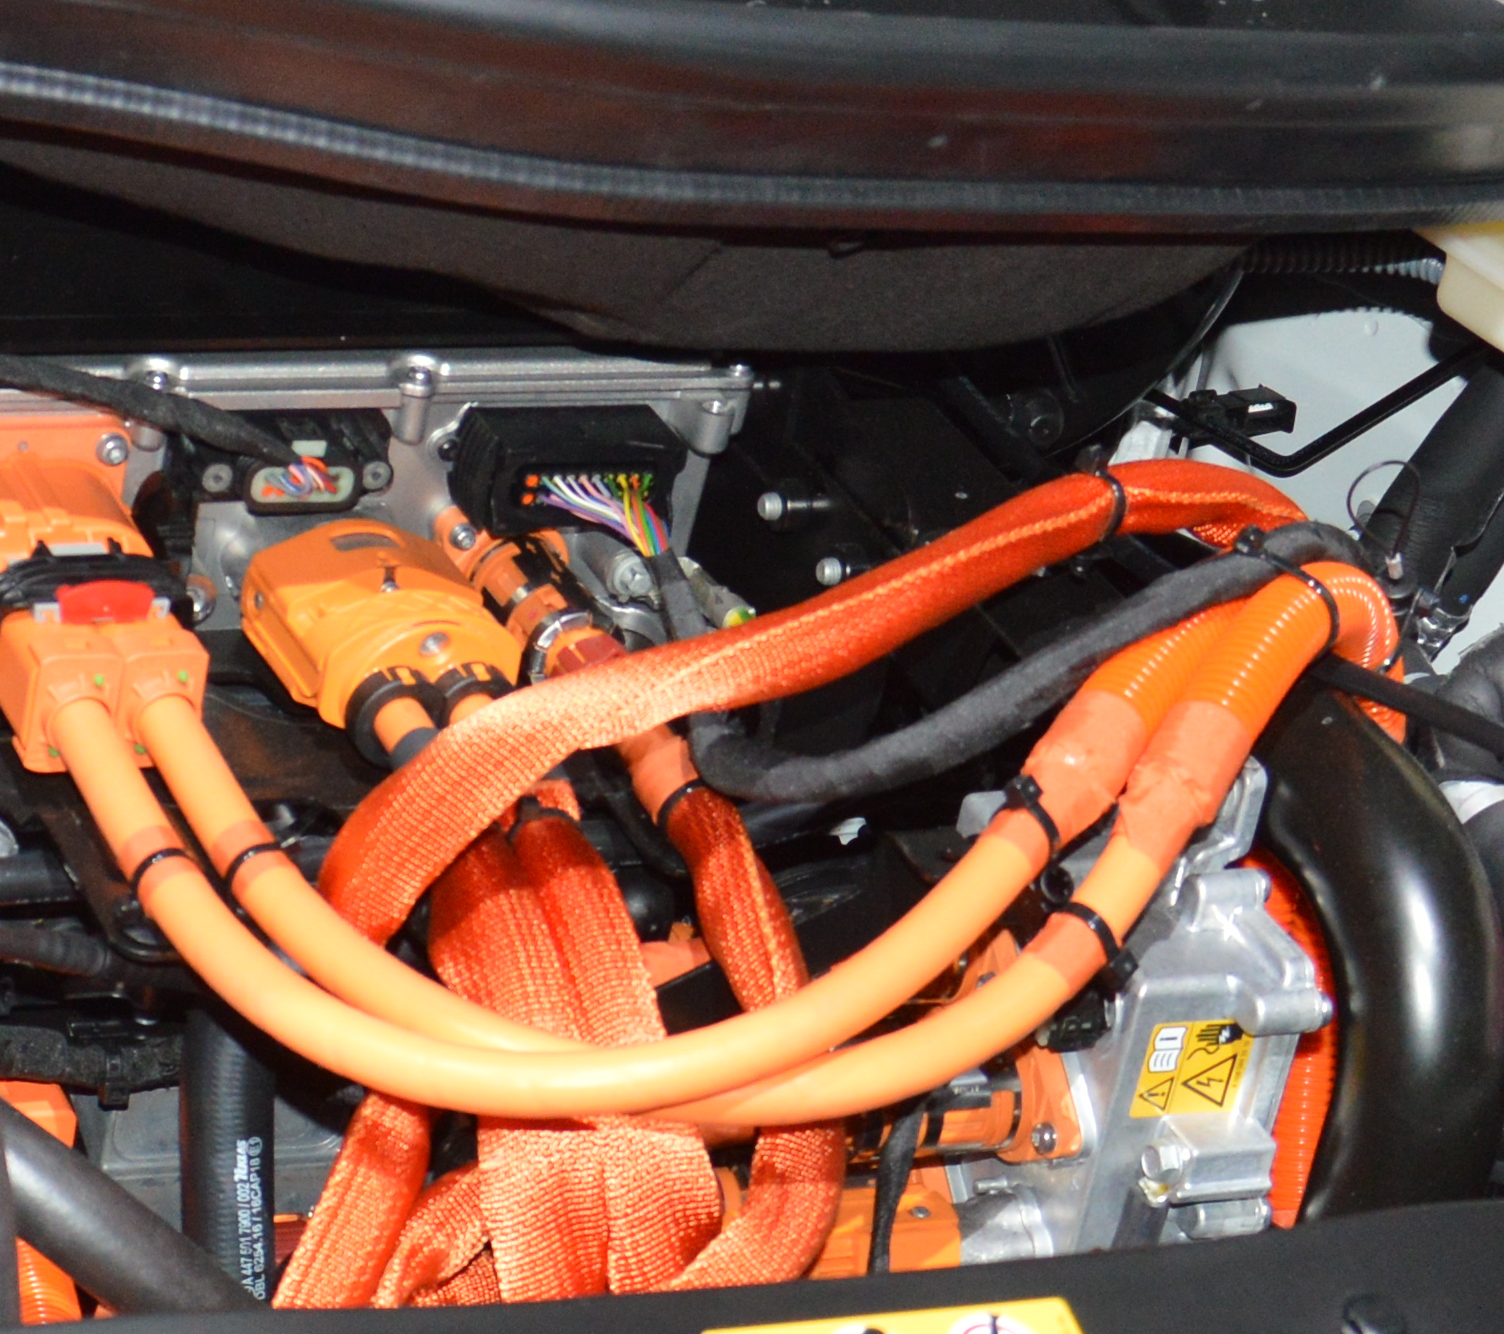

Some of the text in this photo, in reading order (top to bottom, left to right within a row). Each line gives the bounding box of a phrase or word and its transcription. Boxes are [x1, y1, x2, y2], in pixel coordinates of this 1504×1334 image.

[236, 1182, 250, 1202] 002
[238, 1209, 251, 1234] 7900
[239, 1238, 253, 1257] 501
[241, 1258, 253, 1276] 447
